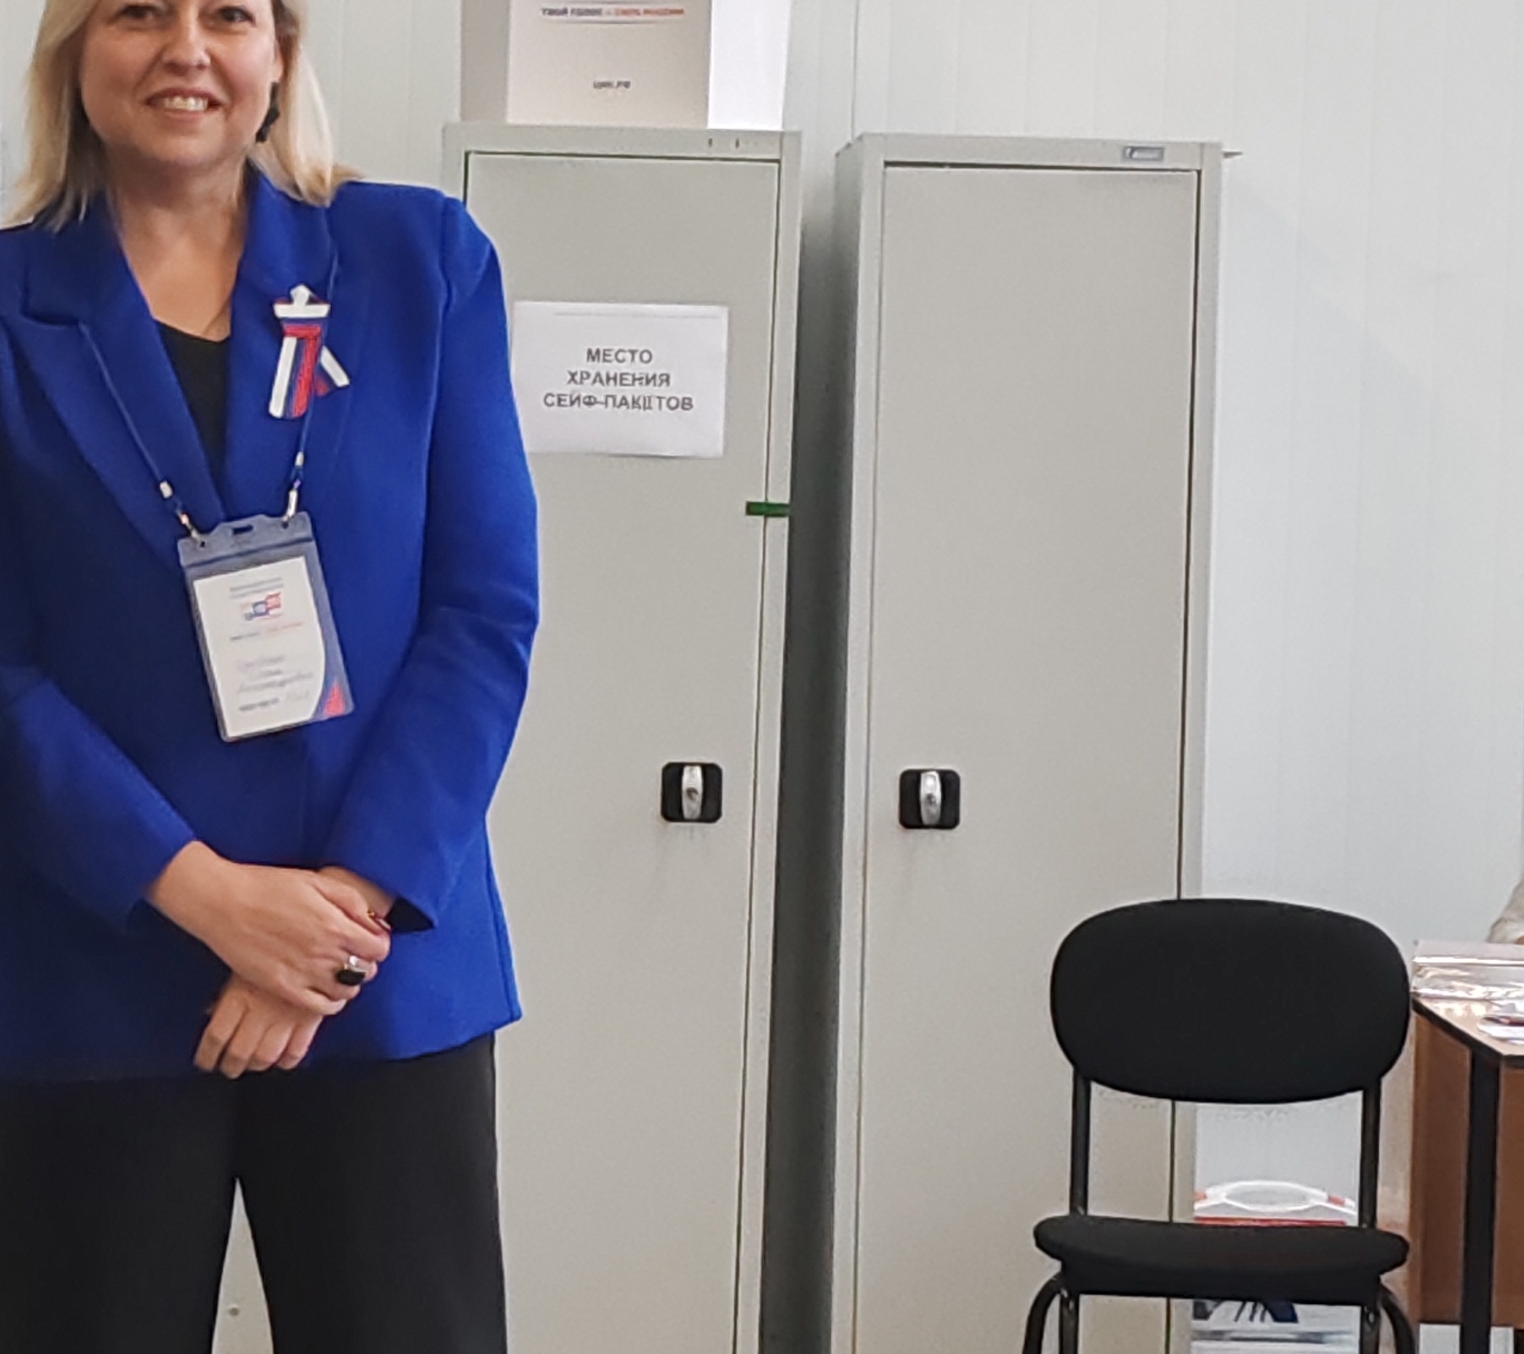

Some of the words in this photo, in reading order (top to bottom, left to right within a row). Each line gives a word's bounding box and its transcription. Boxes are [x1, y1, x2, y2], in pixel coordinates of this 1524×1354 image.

[586, 348, 653, 364] МЕСТО
[567, 370, 671, 387] ХРАНЕНИЯ
[543, 392, 694, 411] СЕЙФ-ПАКЕТОВ
